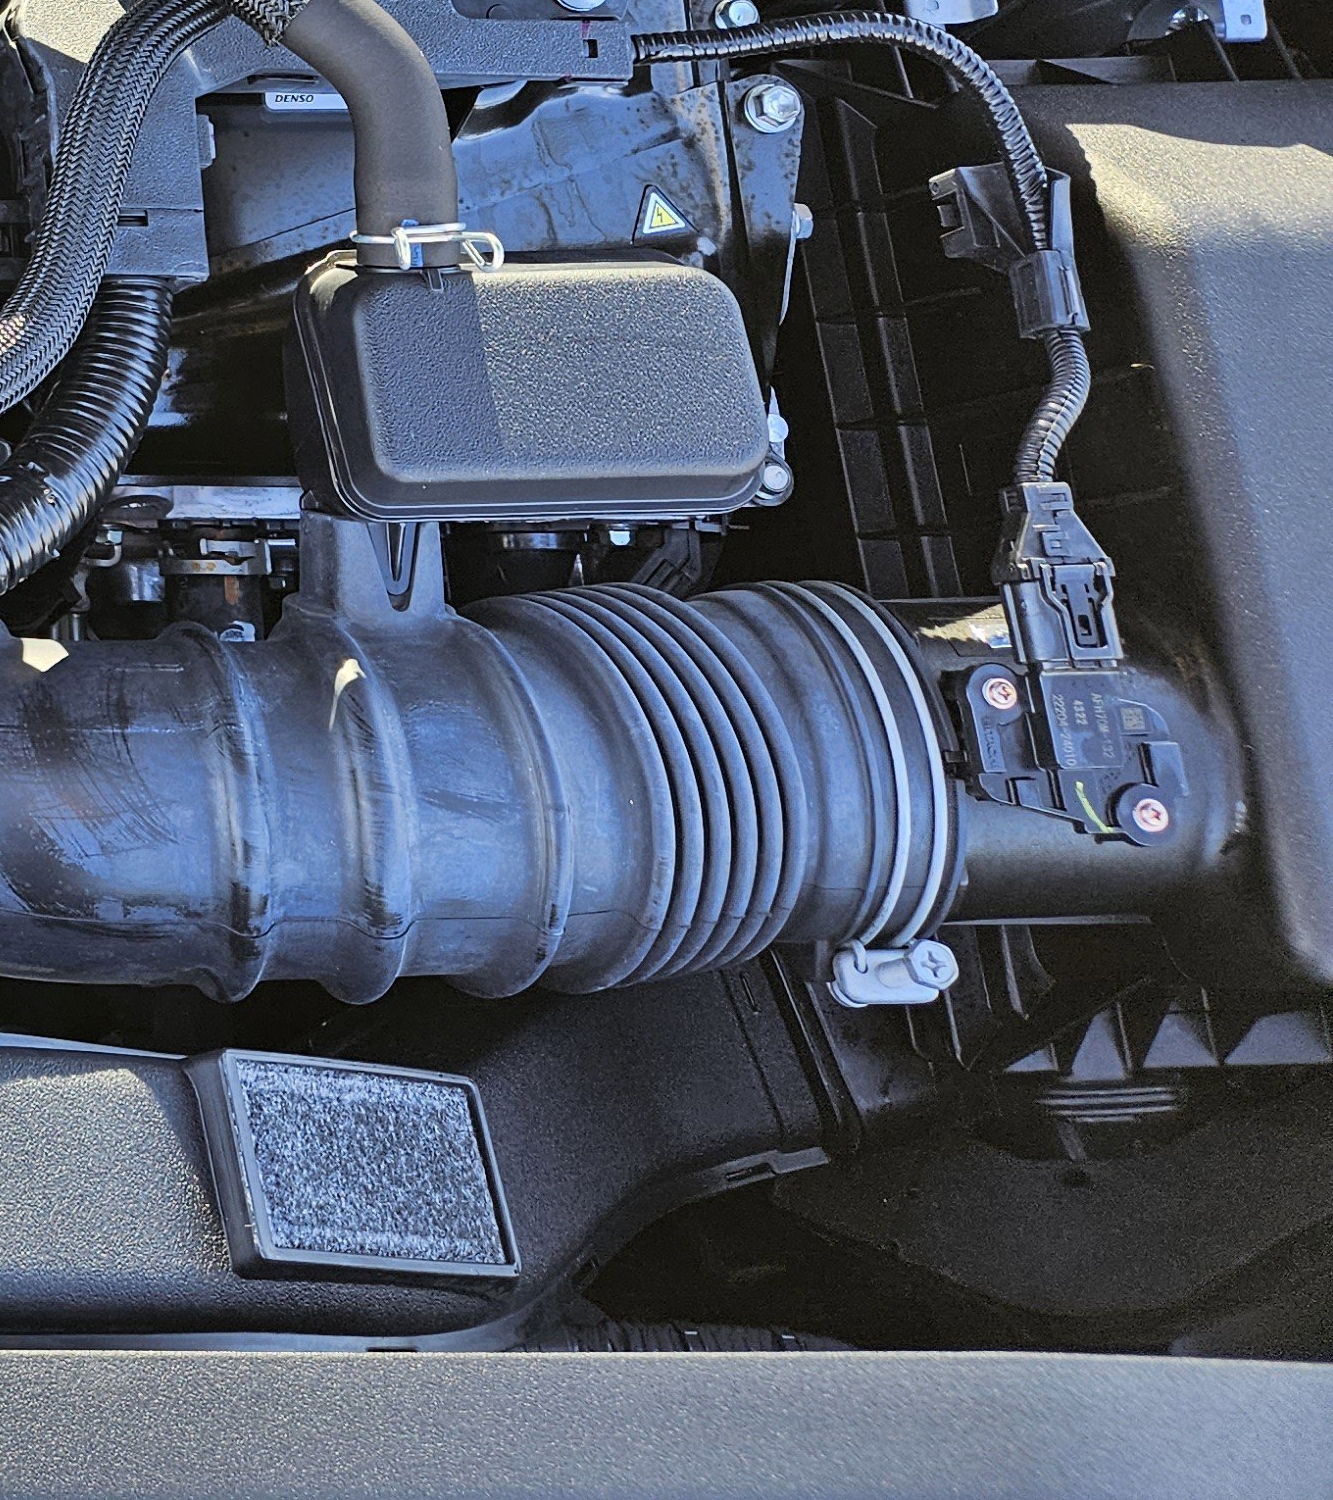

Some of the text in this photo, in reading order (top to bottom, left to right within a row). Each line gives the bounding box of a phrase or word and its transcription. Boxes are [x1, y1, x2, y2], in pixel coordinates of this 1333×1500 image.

[274, 94, 314, 103] DENSO
[1073, 699, 1088, 725] 4322
[1051, 694, 1077, 766] 22204-24010
